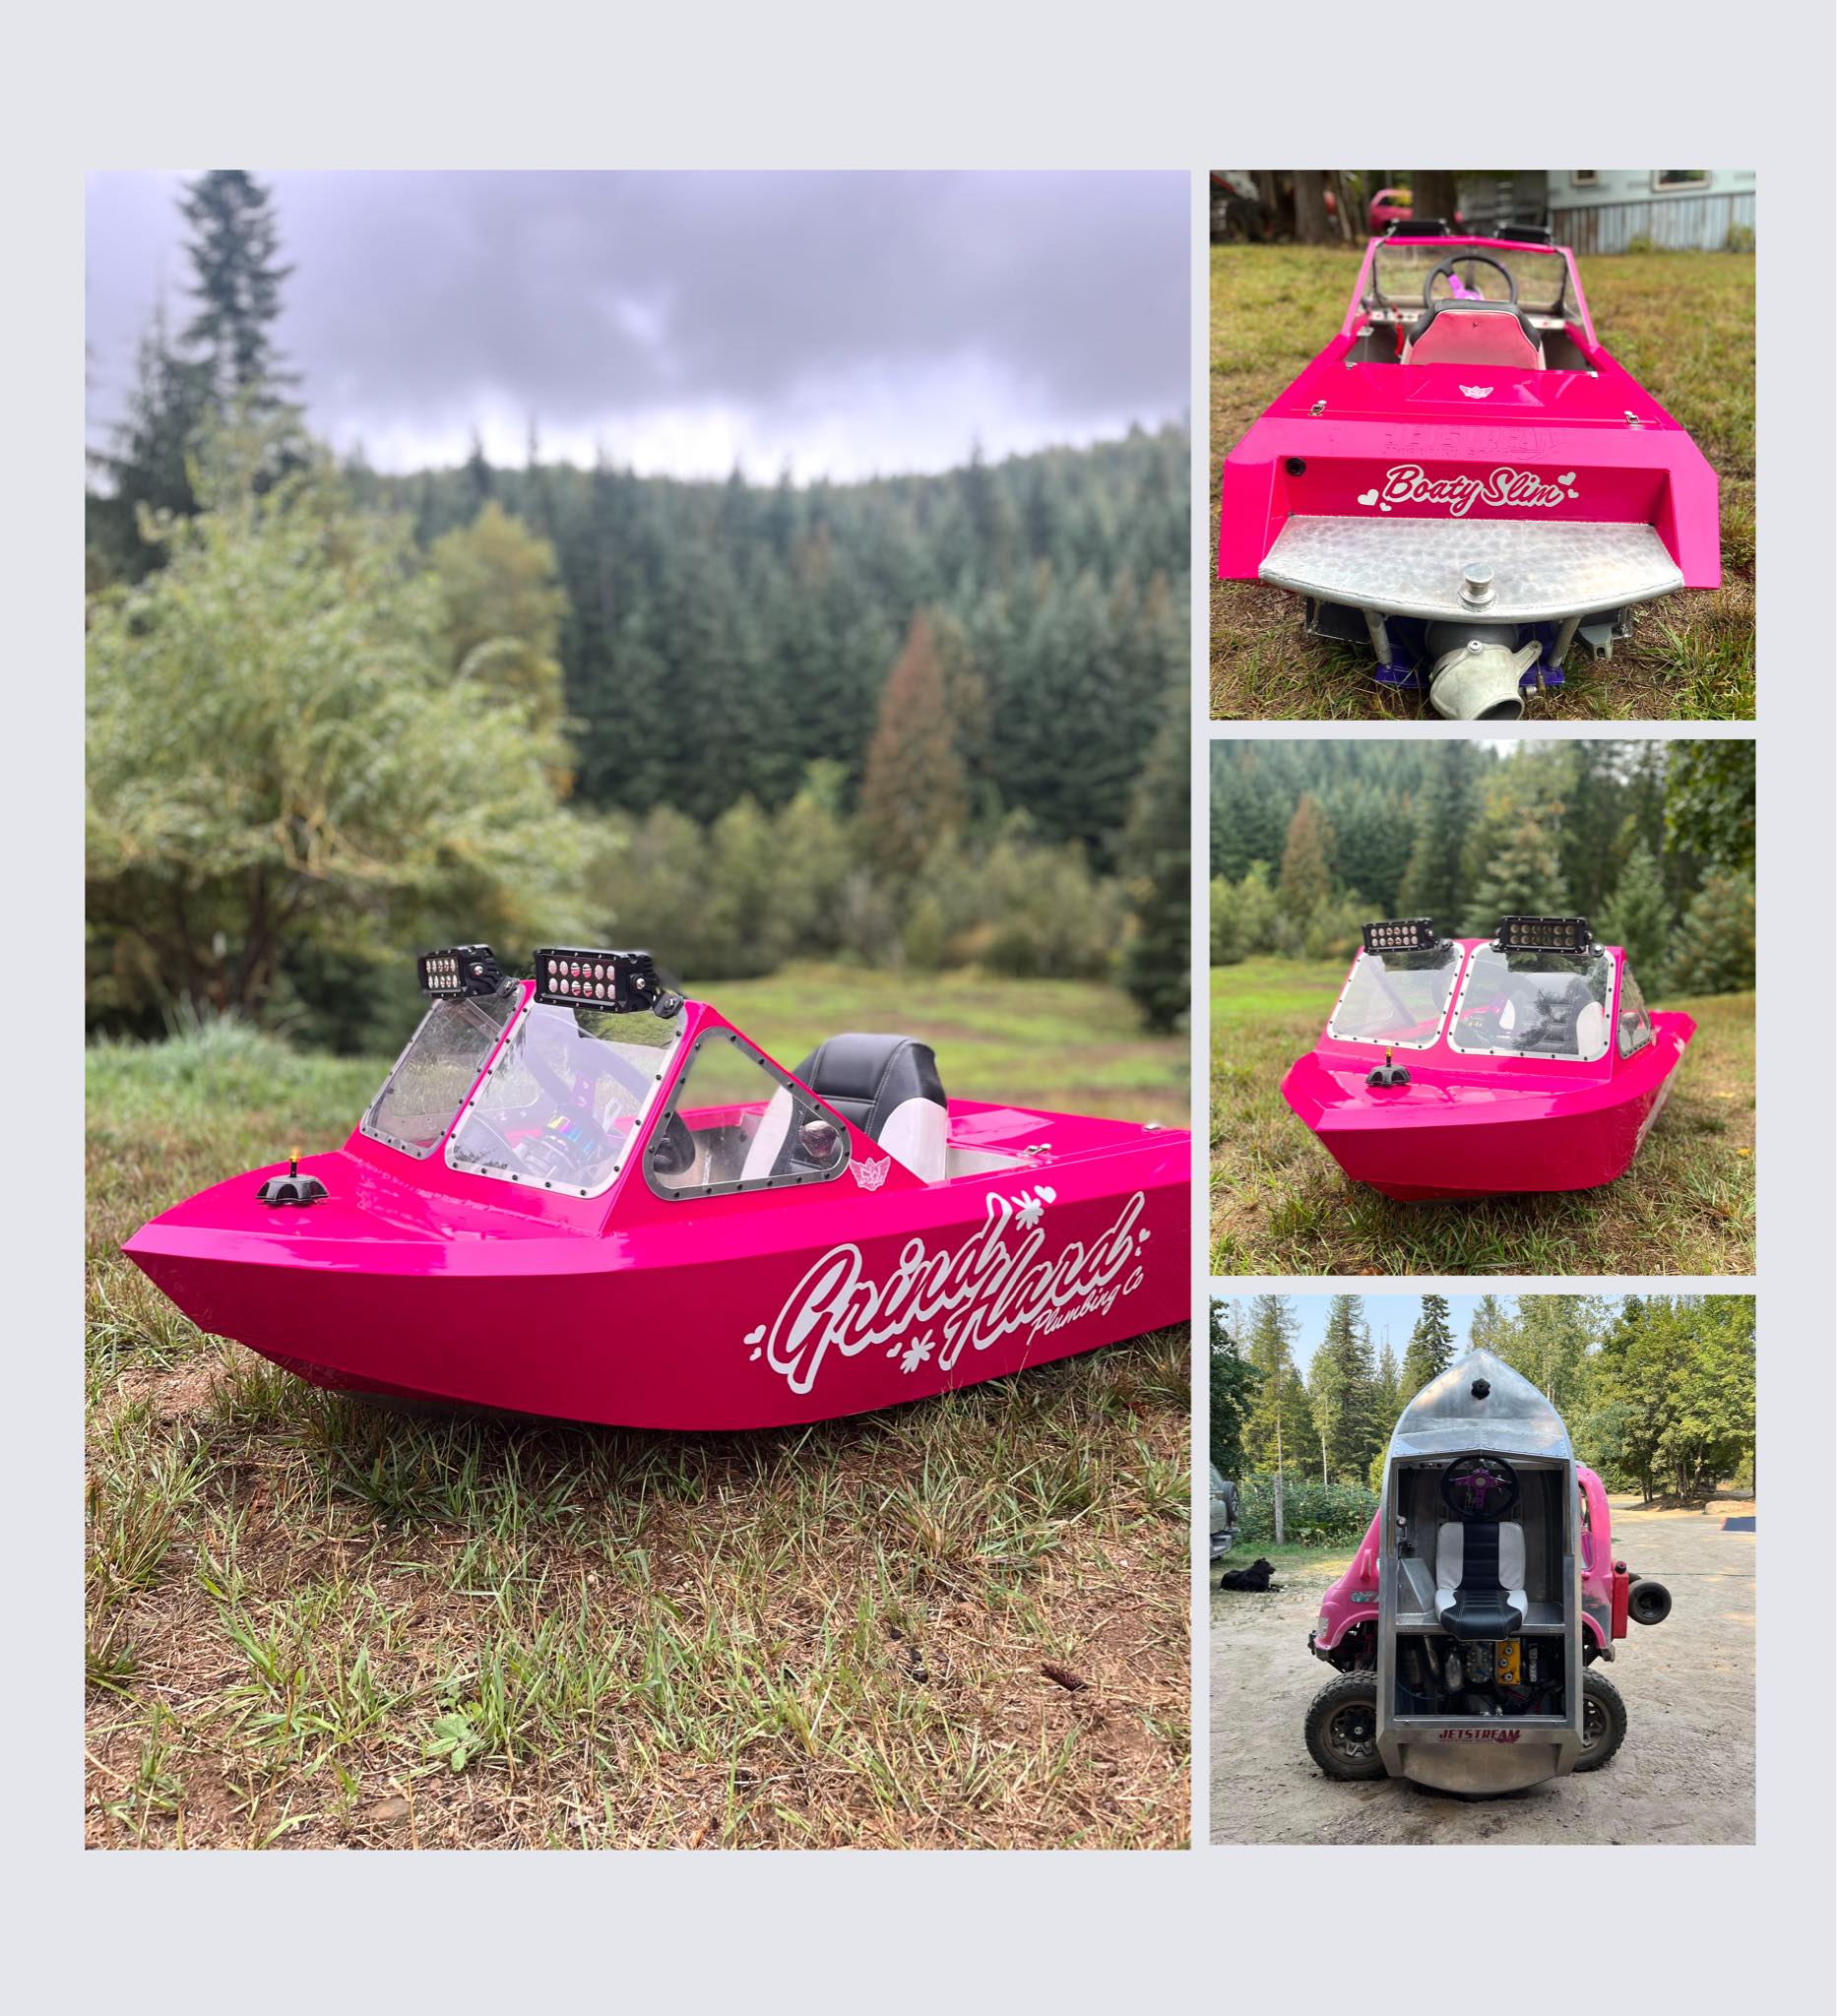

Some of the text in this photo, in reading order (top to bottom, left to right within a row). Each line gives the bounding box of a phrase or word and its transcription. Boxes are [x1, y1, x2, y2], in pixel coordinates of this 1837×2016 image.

[1382, 465, 1563, 517] Boaty Slim
[767, 1192, 1013, 1394] Grind
[938, 1192, 1145, 1370] Hard
[1027, 1267, 1144, 1345] Plumbing Co
[1438, 1730, 1520, 1740] JETSTREAM
